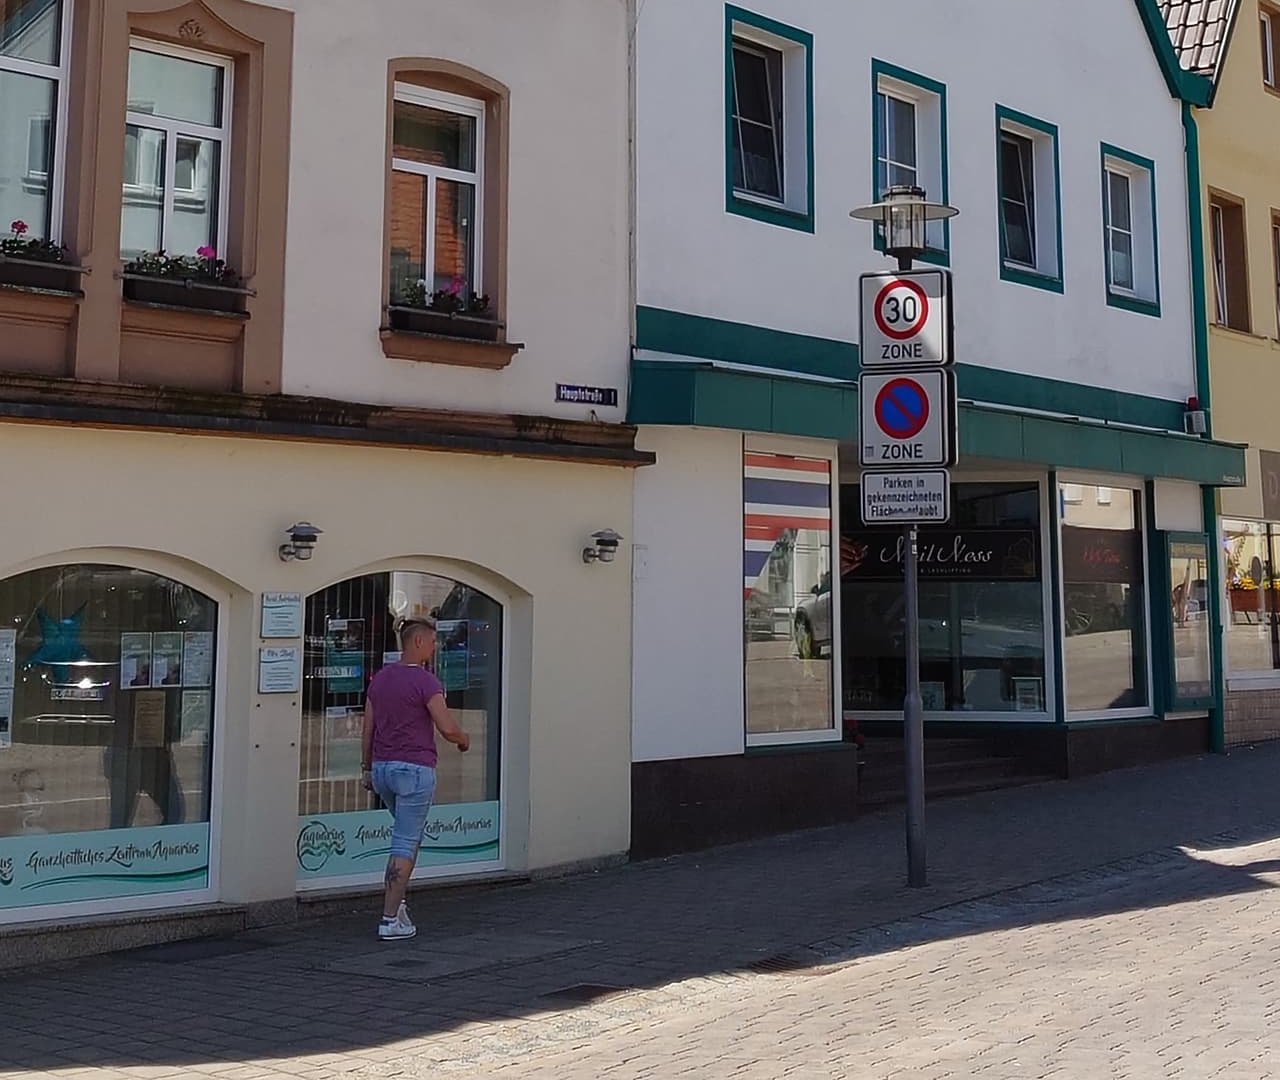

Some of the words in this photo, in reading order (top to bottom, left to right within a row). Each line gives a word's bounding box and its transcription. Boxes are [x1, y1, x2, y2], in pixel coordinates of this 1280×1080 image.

[885, 296, 917, 324] 30
[881, 343, 923, 360] ZONE
[881, 443, 923, 460] ZONE
[883, 476, 913, 489] Parken
[916, 476, 925, 488] in
[867, 490, 943, 506] gekennzeichneten
[303, 828, 346, 846] aquarius
[151, 839, 201, 862] Aquarius
